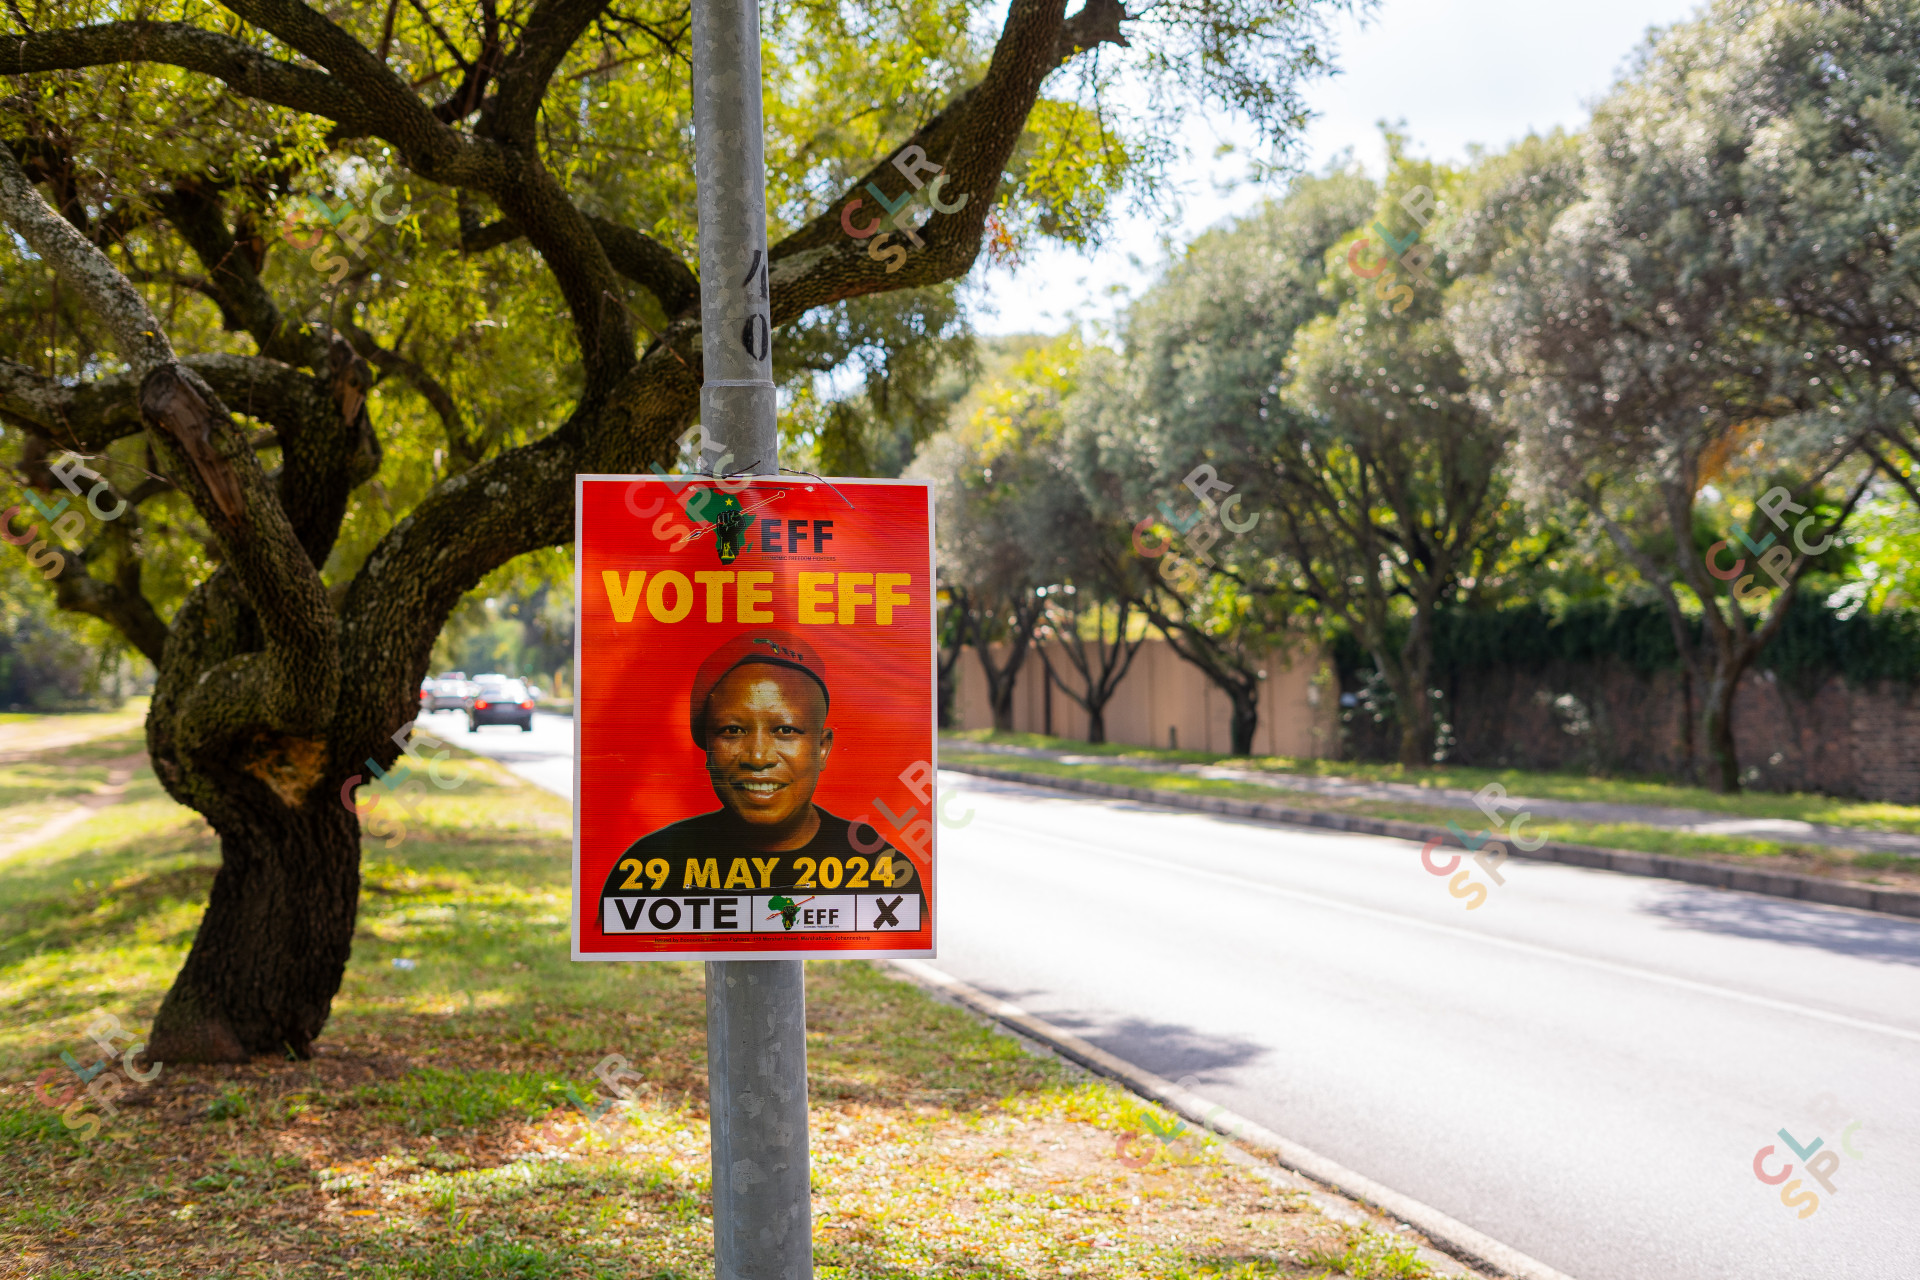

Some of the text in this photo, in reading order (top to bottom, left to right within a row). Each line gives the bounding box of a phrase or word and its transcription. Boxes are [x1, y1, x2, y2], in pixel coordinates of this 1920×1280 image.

[761, 519, 834, 553] EFF
[601, 570, 911, 626] VOTE EFF
[618, 856, 896, 891] 29 MAY 2024
[614, 897, 738, 930] VOTE
[804, 909, 839, 924] EFF
